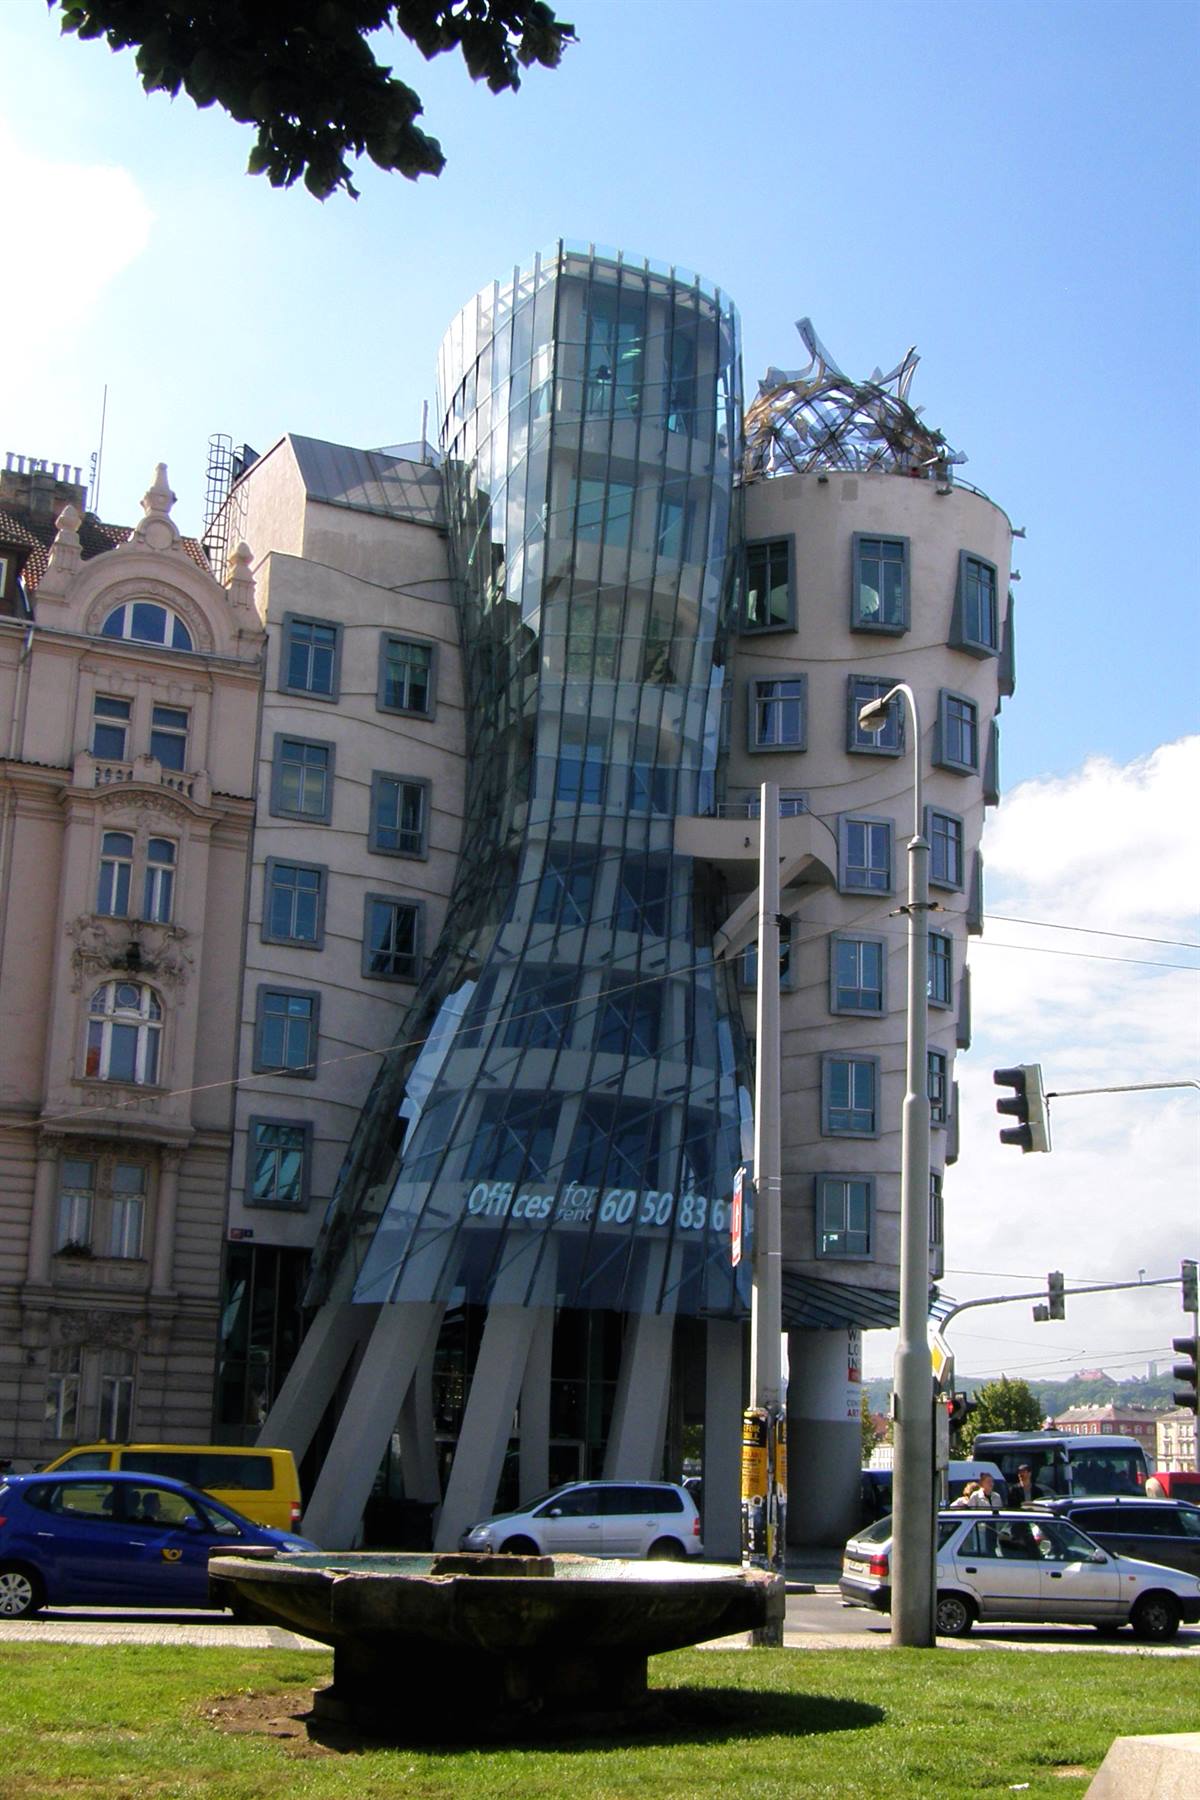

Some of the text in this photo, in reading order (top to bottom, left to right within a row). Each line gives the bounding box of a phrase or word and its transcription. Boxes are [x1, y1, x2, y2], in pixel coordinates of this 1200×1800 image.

[468, 1182, 553, 1219] Offices
[563, 1180, 599, 1206] for
[556, 1206, 593, 1221] rent
[600, 1189, 636, 1223] 60
[639, 1190, 674, 1225] 50
[679, 1193, 707, 1230] 83
